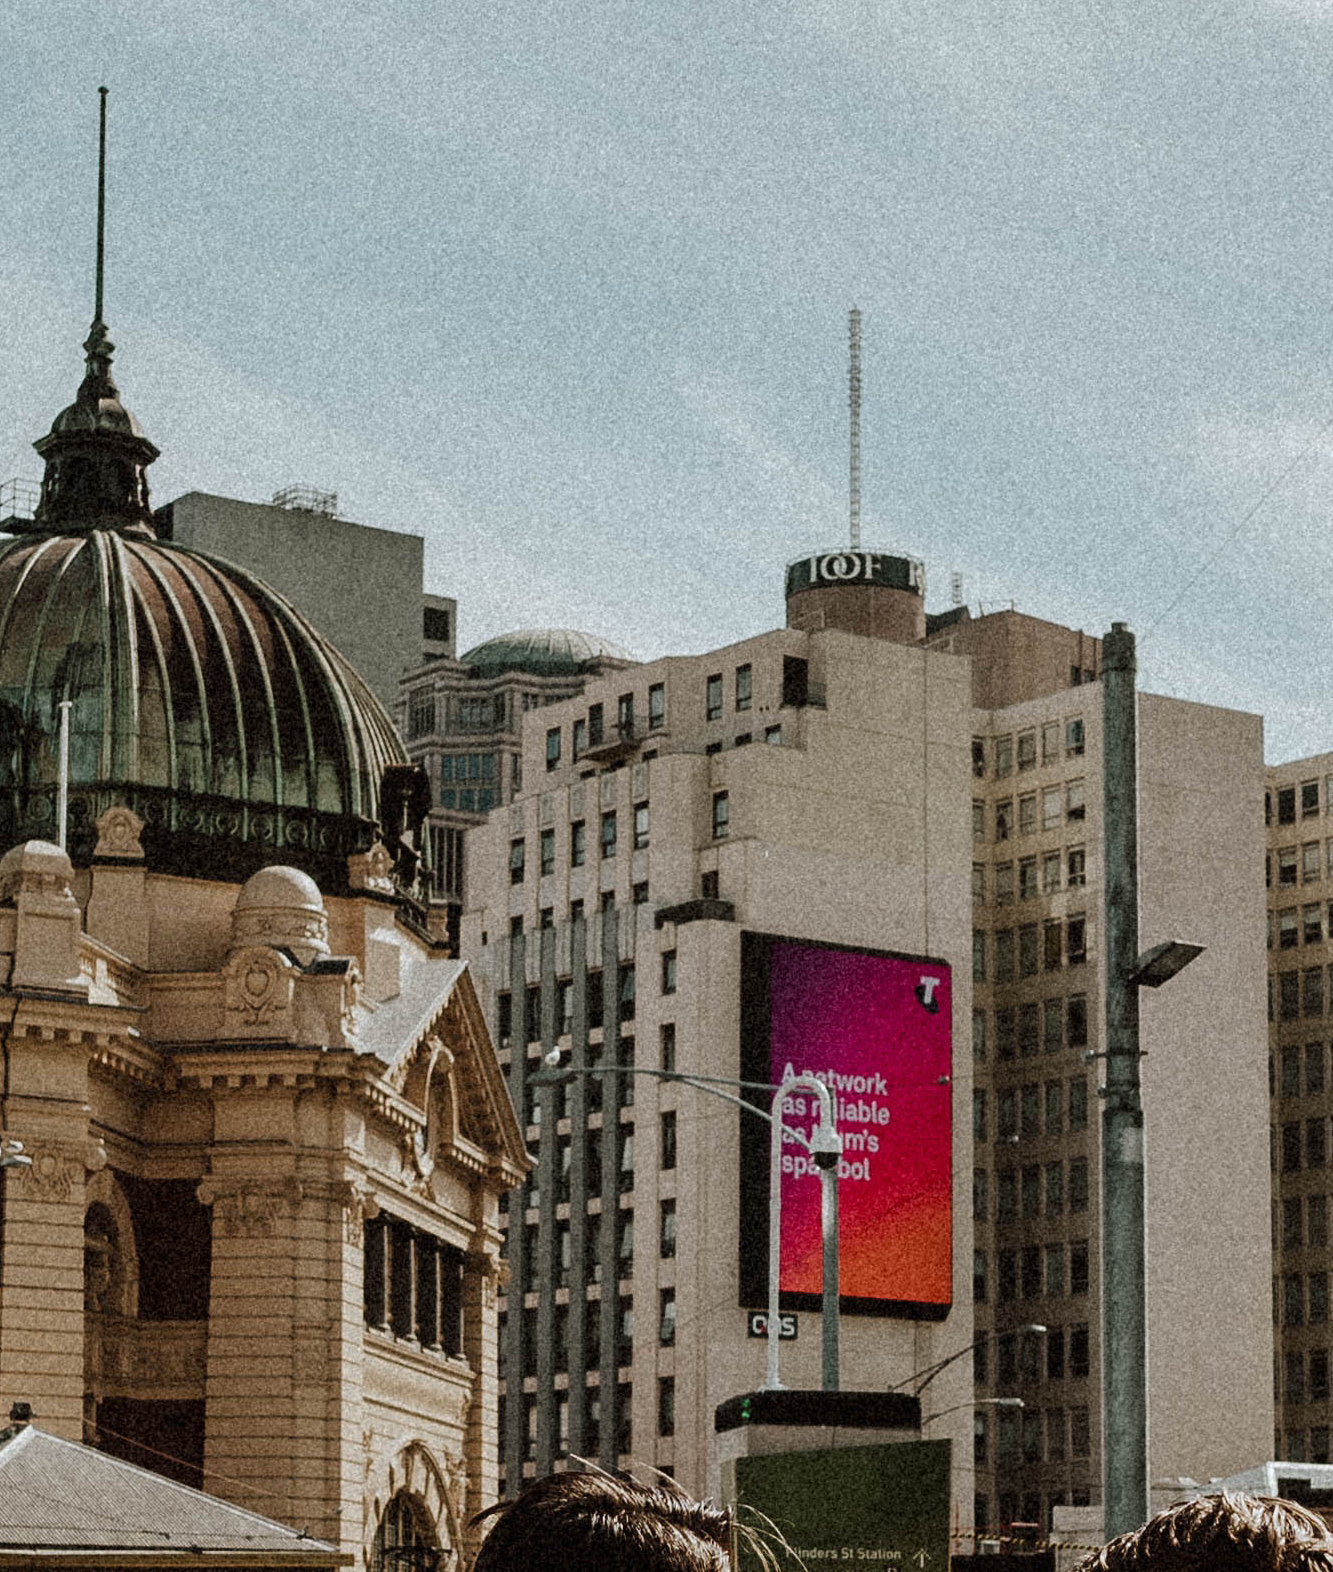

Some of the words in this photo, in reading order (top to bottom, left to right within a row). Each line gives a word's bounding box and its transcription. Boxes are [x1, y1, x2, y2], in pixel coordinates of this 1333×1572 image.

[783, 1097, 806, 1115] as
[812, 1099, 890, 1125] riable
[812, 1124, 879, 1153] m's
[782, 1155, 824, 1179] spa
[753, 1315, 795, 1336] QS
[859, 1548, 901, 1560] Station
